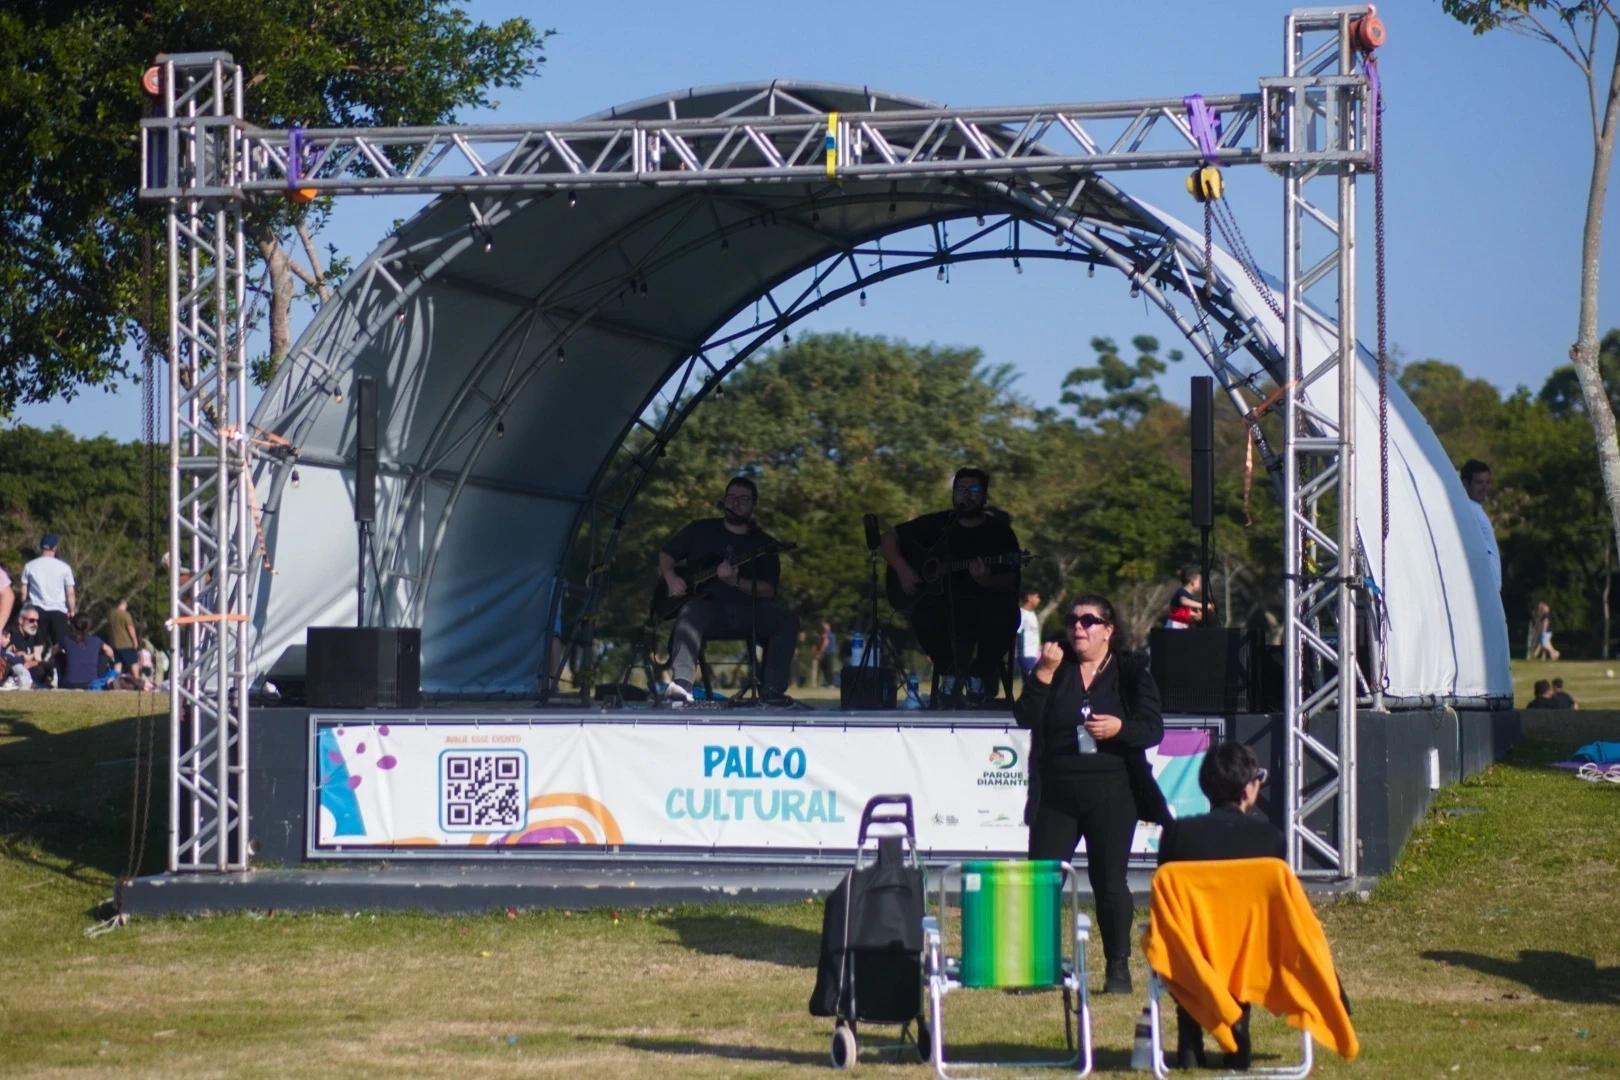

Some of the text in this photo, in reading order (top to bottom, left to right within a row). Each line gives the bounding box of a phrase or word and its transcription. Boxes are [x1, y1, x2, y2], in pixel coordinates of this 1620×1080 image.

[492, 735, 522, 744] EVENTO
[703, 745, 807, 779] PALCO
[665, 788, 845, 823] CULTURAL
